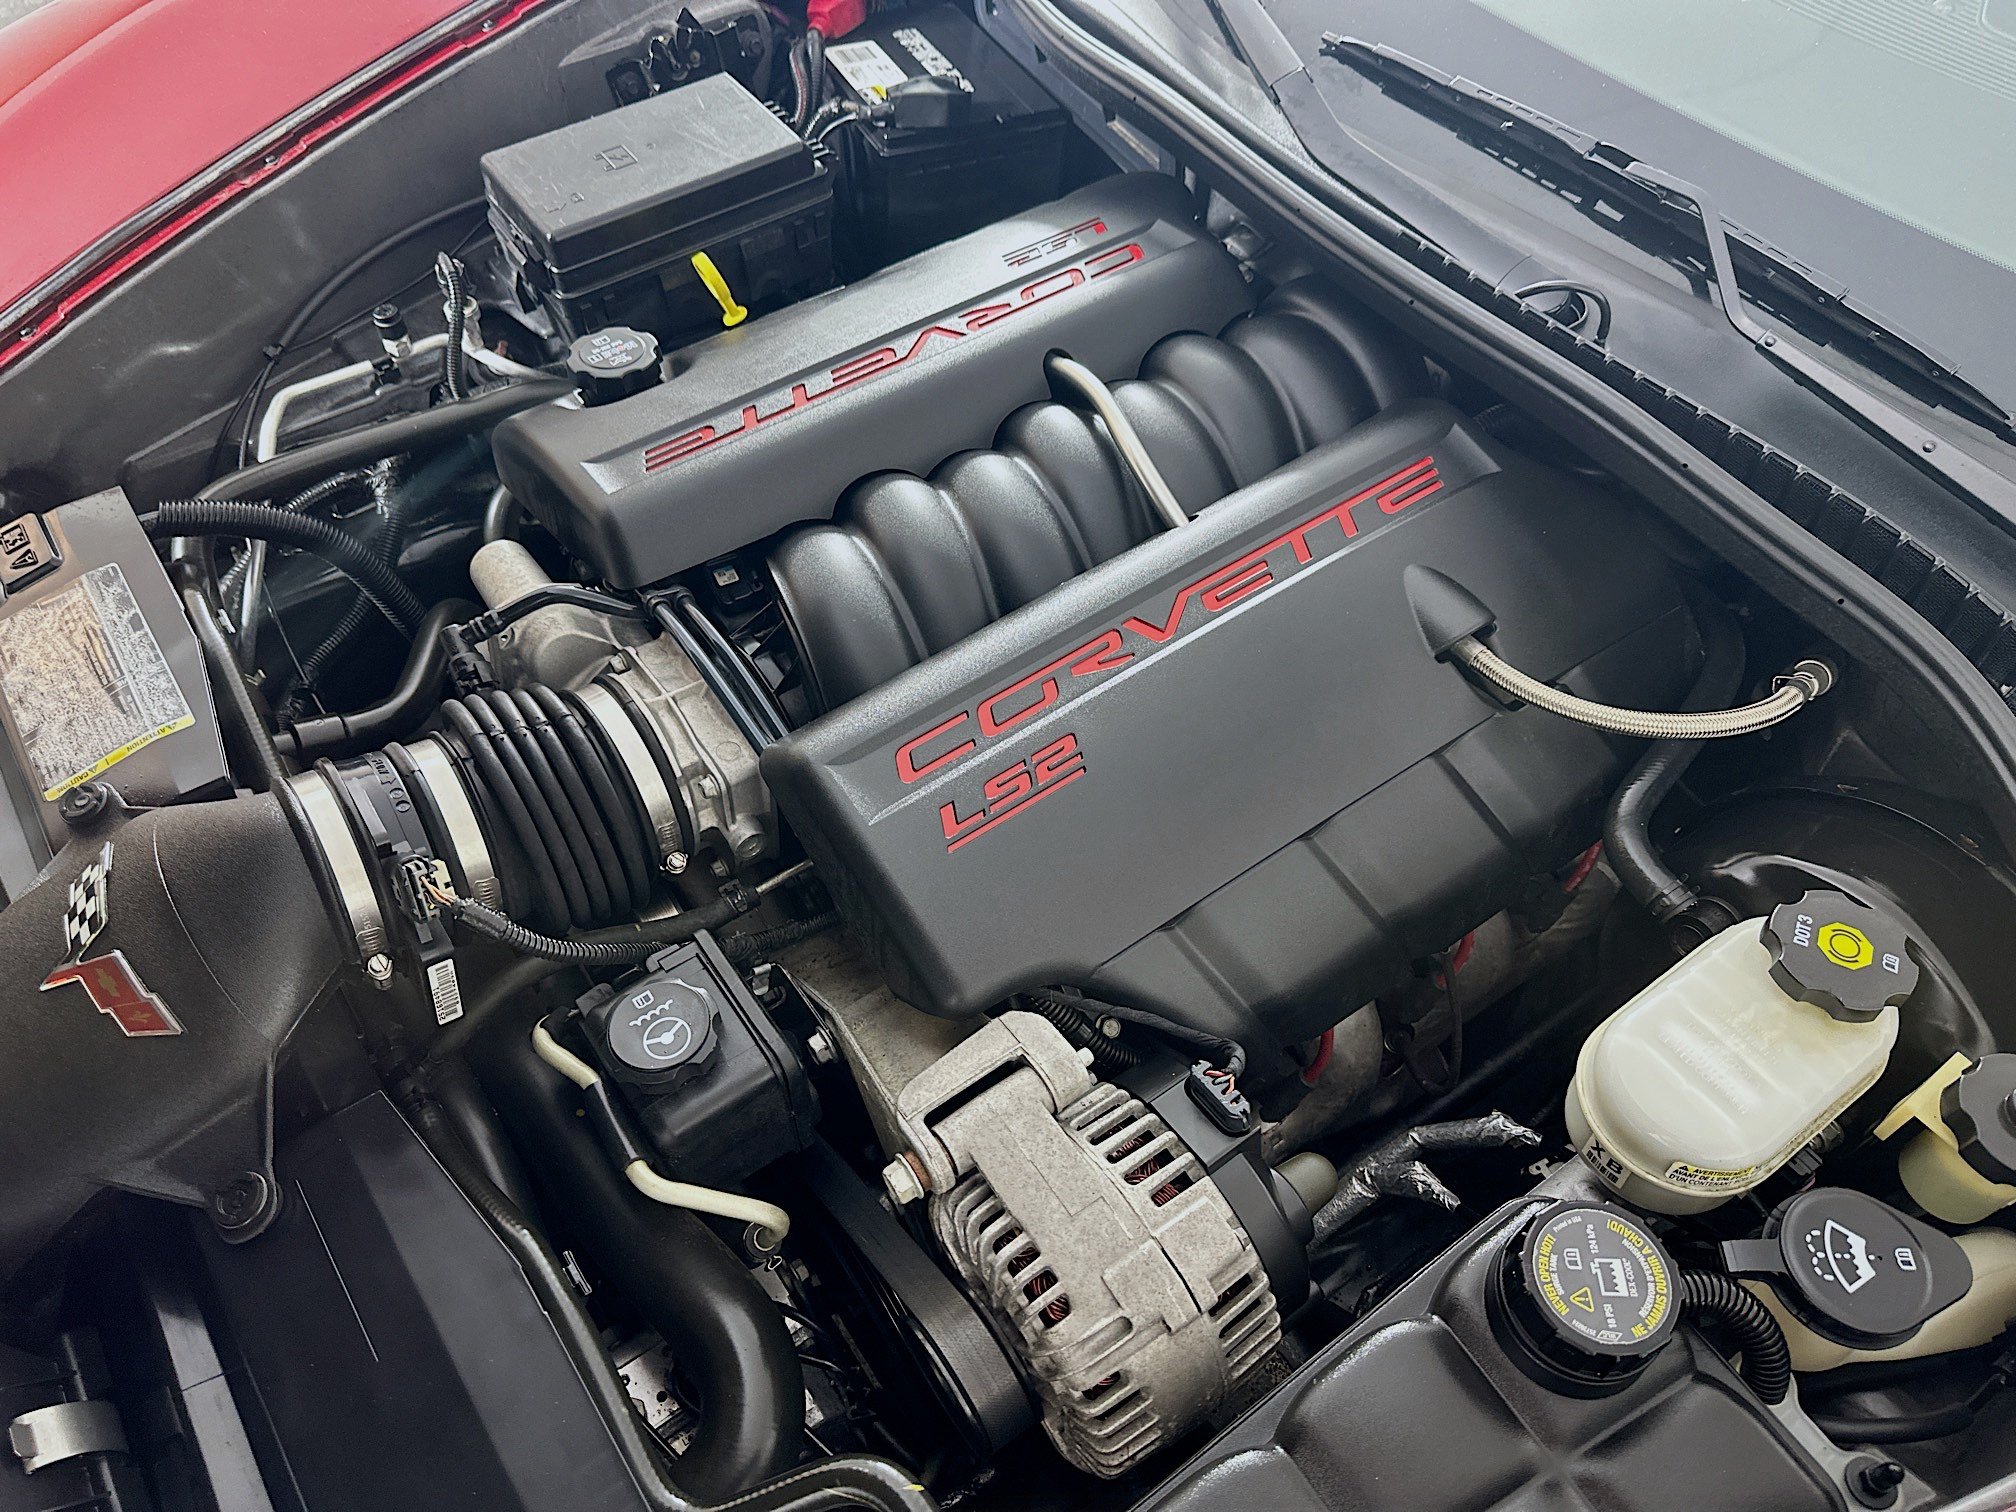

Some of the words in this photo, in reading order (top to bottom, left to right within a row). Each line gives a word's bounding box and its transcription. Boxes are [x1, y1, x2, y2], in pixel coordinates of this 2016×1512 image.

[645, 243, 1144, 472] CORVETTE
[896, 455, 1445, 785] CORVETTE
[939, 732, 1087, 842] LS2
[1797, 914, 1813, 925] 3
[1792, 921, 1812, 948] DOT
[1591, 1140, 1606, 1159] X
[1605, 1158, 1624, 1175] B
[1669, 1174, 1688, 1184] D'UN
[1672, 1169, 1698, 1181] AVANT
[1586, 1224, 1596, 1240] kPa
[1606, 1219, 1644, 1247] CHAUD!
[1540, 1233, 1556, 1256] HOT!
[1588, 1239, 1599, 1254] 124
[1538, 1256, 1550, 1282] OPEN
[1549, 1253, 1558, 1272] TANK
[1647, 1255, 1667, 1294] OUVRIR
[1550, 1272, 1564, 1296] SURGE
[1544, 1283, 1569, 1316] NEVER
[1603, 1304, 1614, 1319] PSI
[1607, 1318, 1617, 1329] 18
[1645, 1294, 1667, 1330] JAMAIS
[1631, 1323, 1648, 1338] NE
